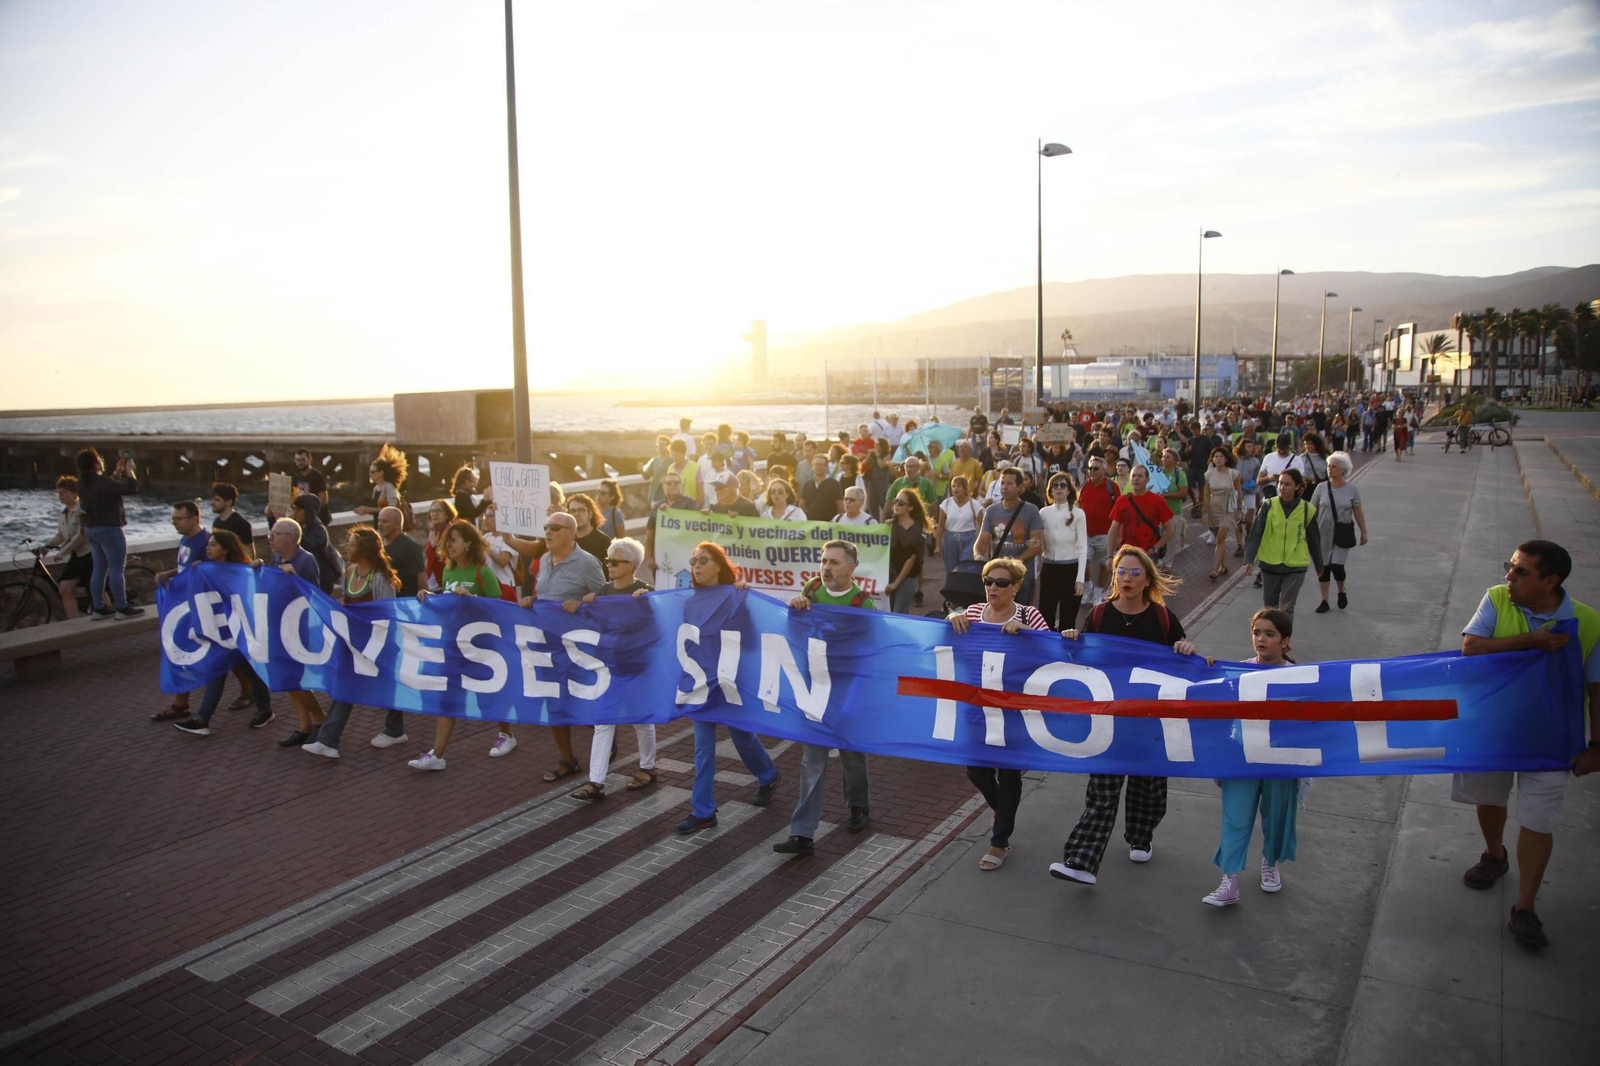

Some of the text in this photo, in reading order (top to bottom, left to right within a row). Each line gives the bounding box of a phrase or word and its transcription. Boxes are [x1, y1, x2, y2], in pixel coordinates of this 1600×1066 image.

[495, 466, 513, 487] CABO
[521, 468, 540, 488] GATA
[511, 490, 525, 504] NO
[501, 506, 509, 526] SE
[660, 515, 889, 547] Los vecinos y vecinas del parque
[765, 546, 822, 566] QUERE
[161, 590, 1446, 766] GENOVESES SIN HOTEL
